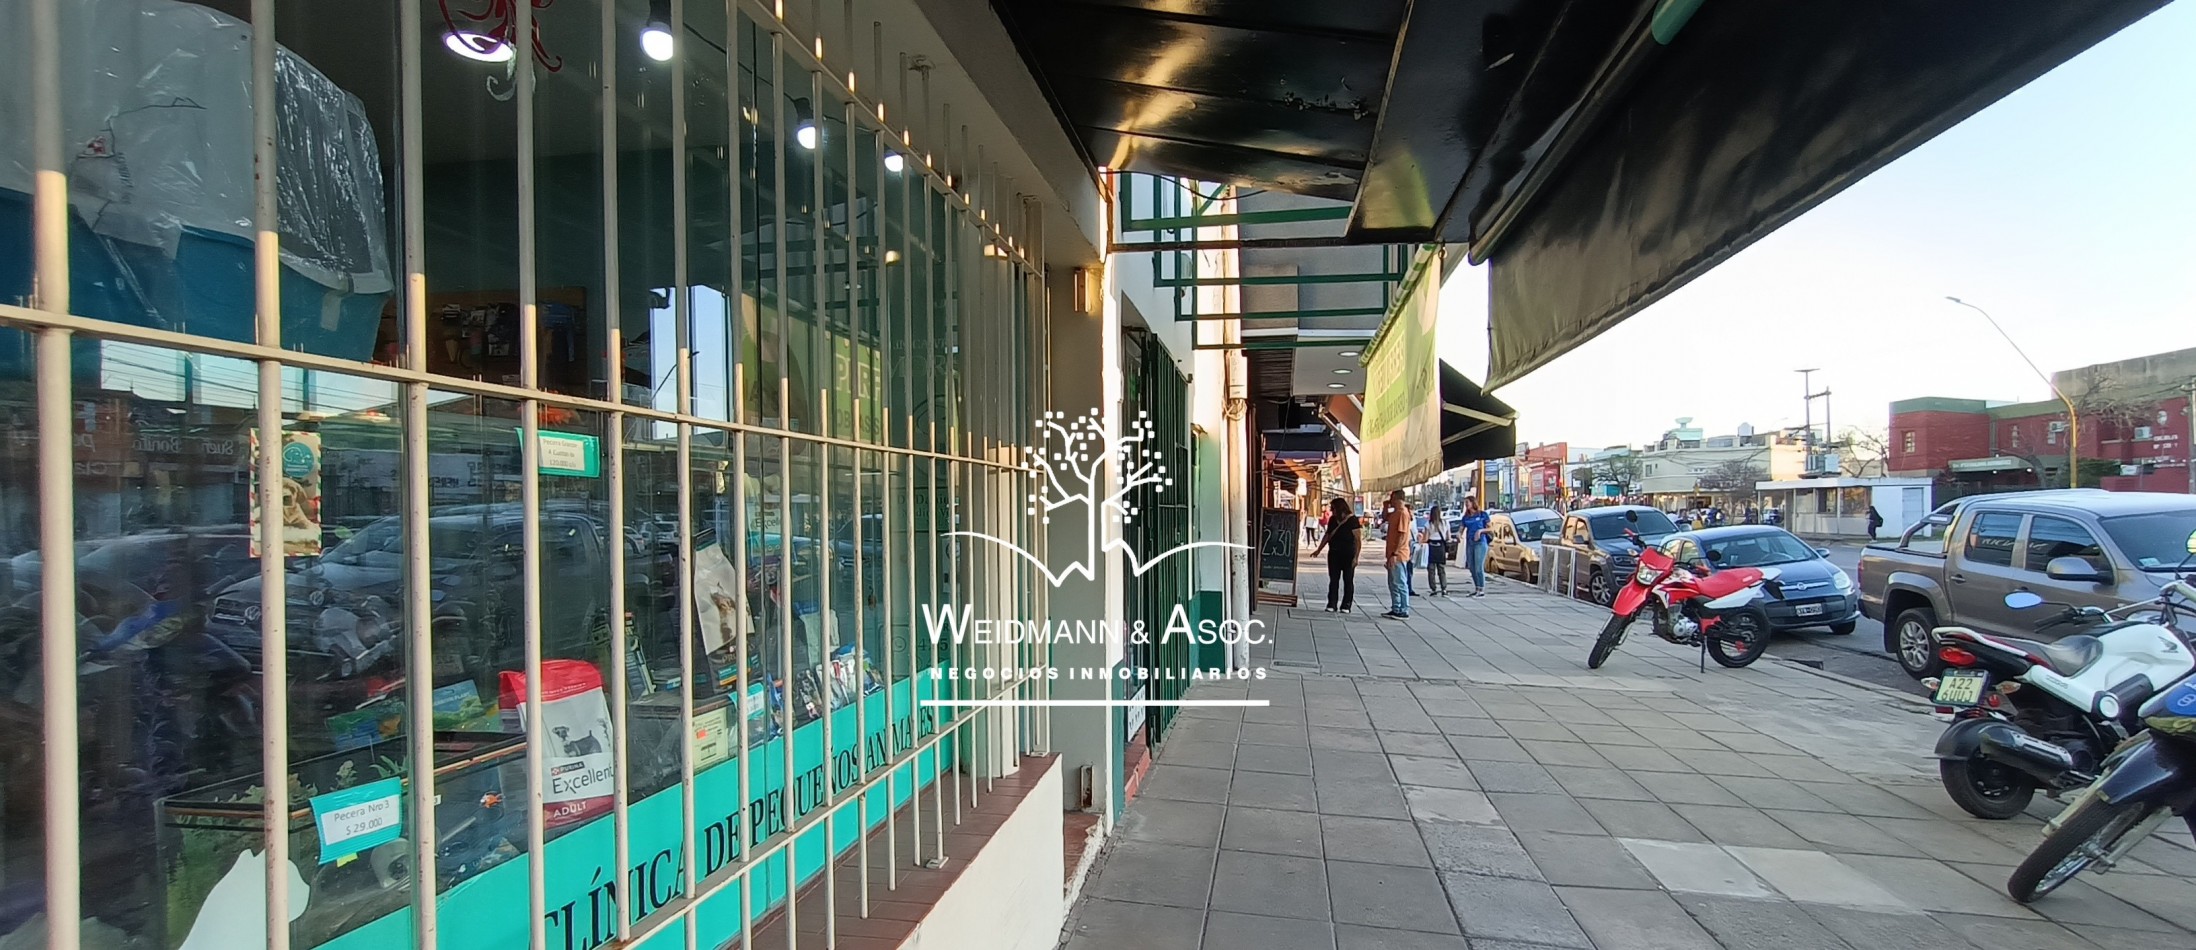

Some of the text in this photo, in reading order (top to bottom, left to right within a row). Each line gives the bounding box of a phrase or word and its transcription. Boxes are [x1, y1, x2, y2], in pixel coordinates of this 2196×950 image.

[1949, 677, 1973, 690] A22
[561, 761, 584, 773] PURINA
[334, 808, 366, 822] Pecera
[385, 800, 390, 808] 3
[553, 801, 587, 818] ADULT
[346, 817, 383, 836] $ 29.000
[704, 812, 740, 878] DE
